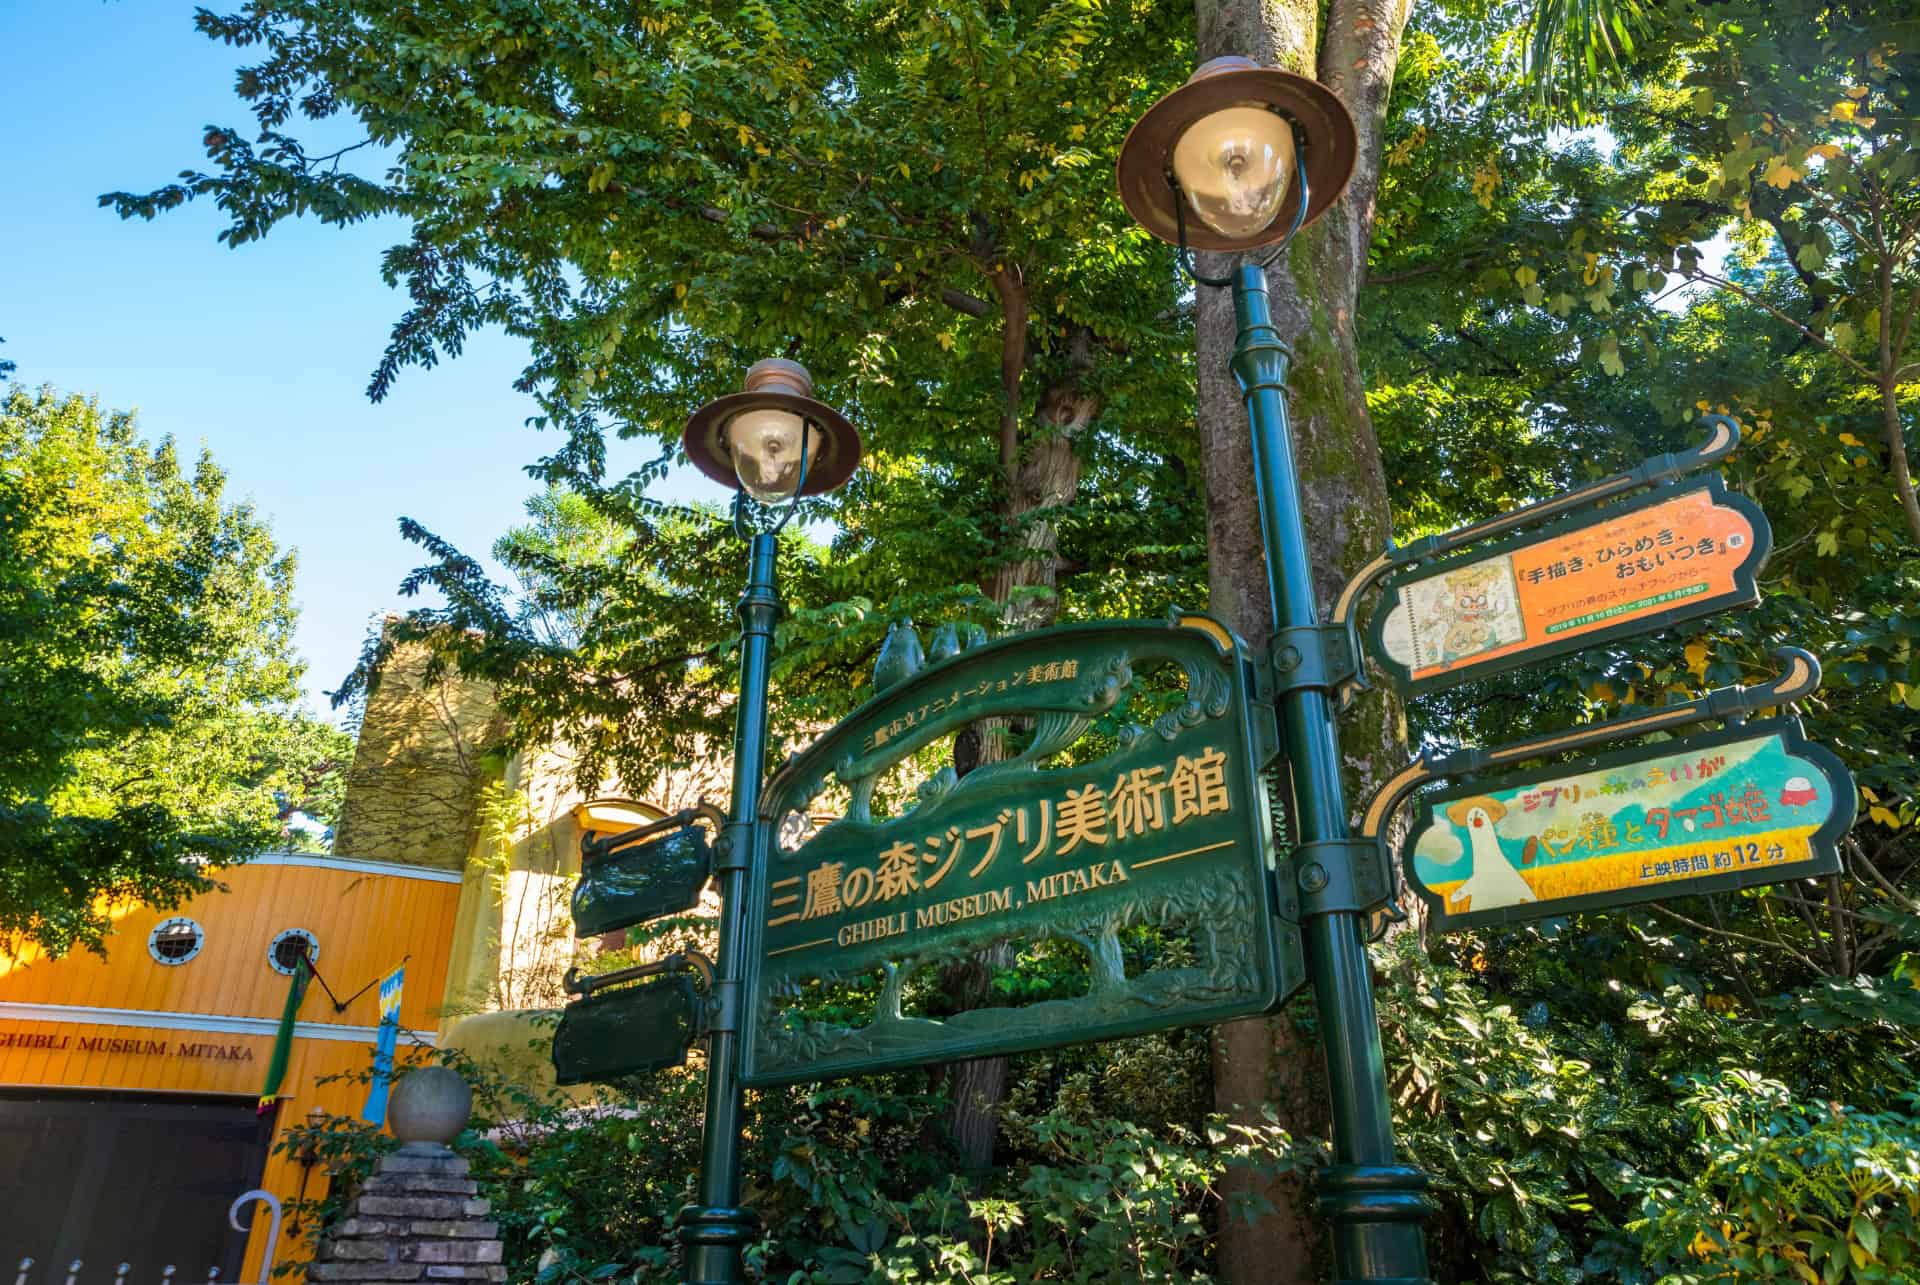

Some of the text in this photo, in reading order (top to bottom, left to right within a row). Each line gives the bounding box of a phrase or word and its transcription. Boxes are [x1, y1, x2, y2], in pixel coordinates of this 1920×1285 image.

[863, 659, 1080, 754] 三鷹市立アニメーション美術館
[768, 747, 1229, 926] 三鷹の森ジブリ美術館
[838, 911, 908, 947] GHIBLI
[1027, 859, 1128, 904] MITAKA
[179, 1042, 254, 1061] MITAKA
